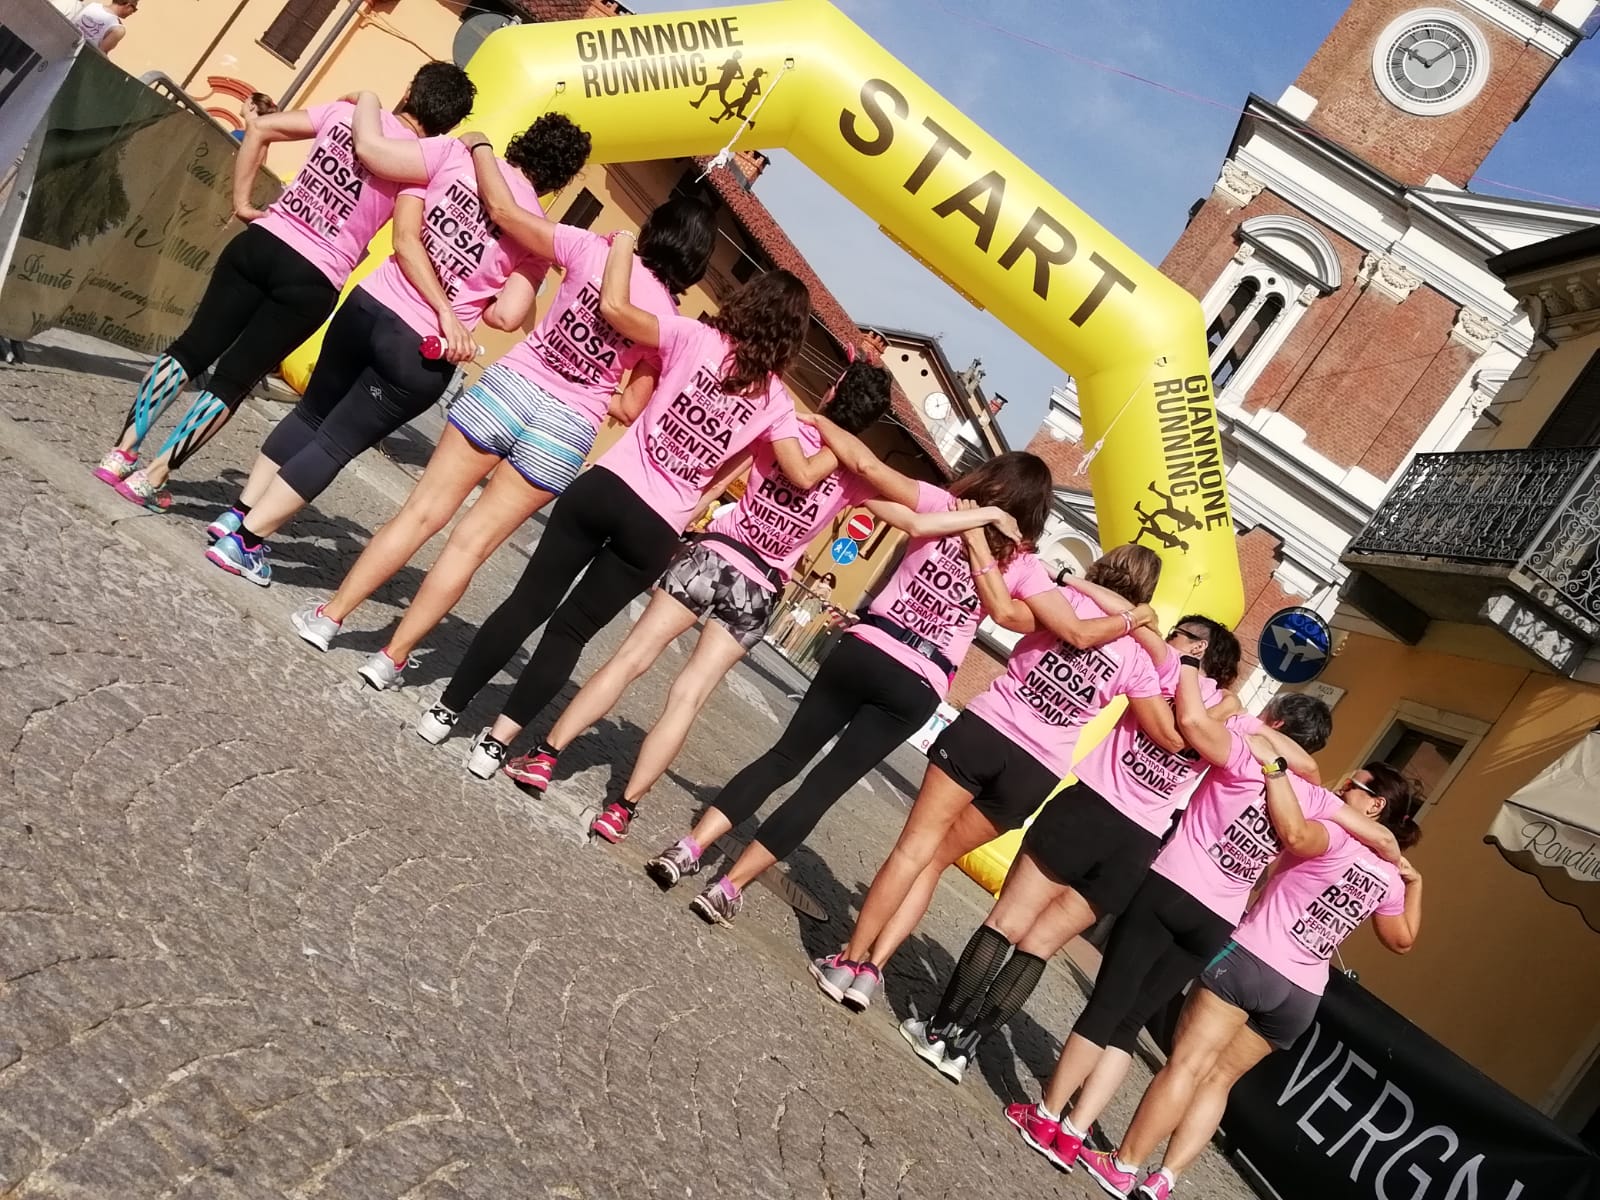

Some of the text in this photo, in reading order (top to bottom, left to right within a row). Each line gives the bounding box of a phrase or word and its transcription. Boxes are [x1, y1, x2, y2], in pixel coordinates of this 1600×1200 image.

[576, 17, 743, 62] GIANNONE
[582, 52, 707, 98] RUNNING
[297, 168, 354, 221] NIENTE
[310, 146, 363, 201] ROSA
[281, 190, 340, 237] DONNE
[294, 185, 338, 225] FERMA LE
[446, 203, 487, 242] FERMA IL
[839, 78, 1137, 327] START
[427, 205, 485, 264] ROSA
[18, 254, 75, 290] Piante
[98, 315, 145, 347] Torinese
[559, 308, 616, 368] ROSA
[576, 307, 610, 341] FERMA
[544, 329, 603, 384] NIENTE
[672, 392, 733, 450] ROSA
[691, 390, 735, 428] FERMA IL
[647, 434, 702, 484] DONNE
[656, 413, 720, 468] NIENTE
[657, 432, 690, 463] FERMA
[1153, 378, 1200, 497] RUNNING
[1184, 374, 1229, 532] GIANNONE
[749, 500, 808, 539] NIENTE
[758, 478, 819, 522] ROSA
[739, 516, 792, 557] DONNE
[781, 533, 793, 545] LE
[919, 559, 979, 612] ROSA
[937, 556, 971, 586] FERMA
[906, 581, 968, 626] NIENTE
[906, 598, 938, 624] FERMA
[1039, 651, 1096, 704] ROSA
[1060, 650, 1097, 685] FERMA IL
[1024, 670, 1085, 718] NIENTE
[1121, 750, 1177, 795] DONNE
[1134, 731, 1191, 778] NIENTE
[1136, 749, 1165, 776] FERMA
[1166, 773, 1178, 782] LE
[1223, 842, 1251, 867] FERMA
[1306, 901, 1353, 938] NIENT
[1321, 884, 1370, 921] ROSA
[1305, 917, 1336, 943] FERMA
